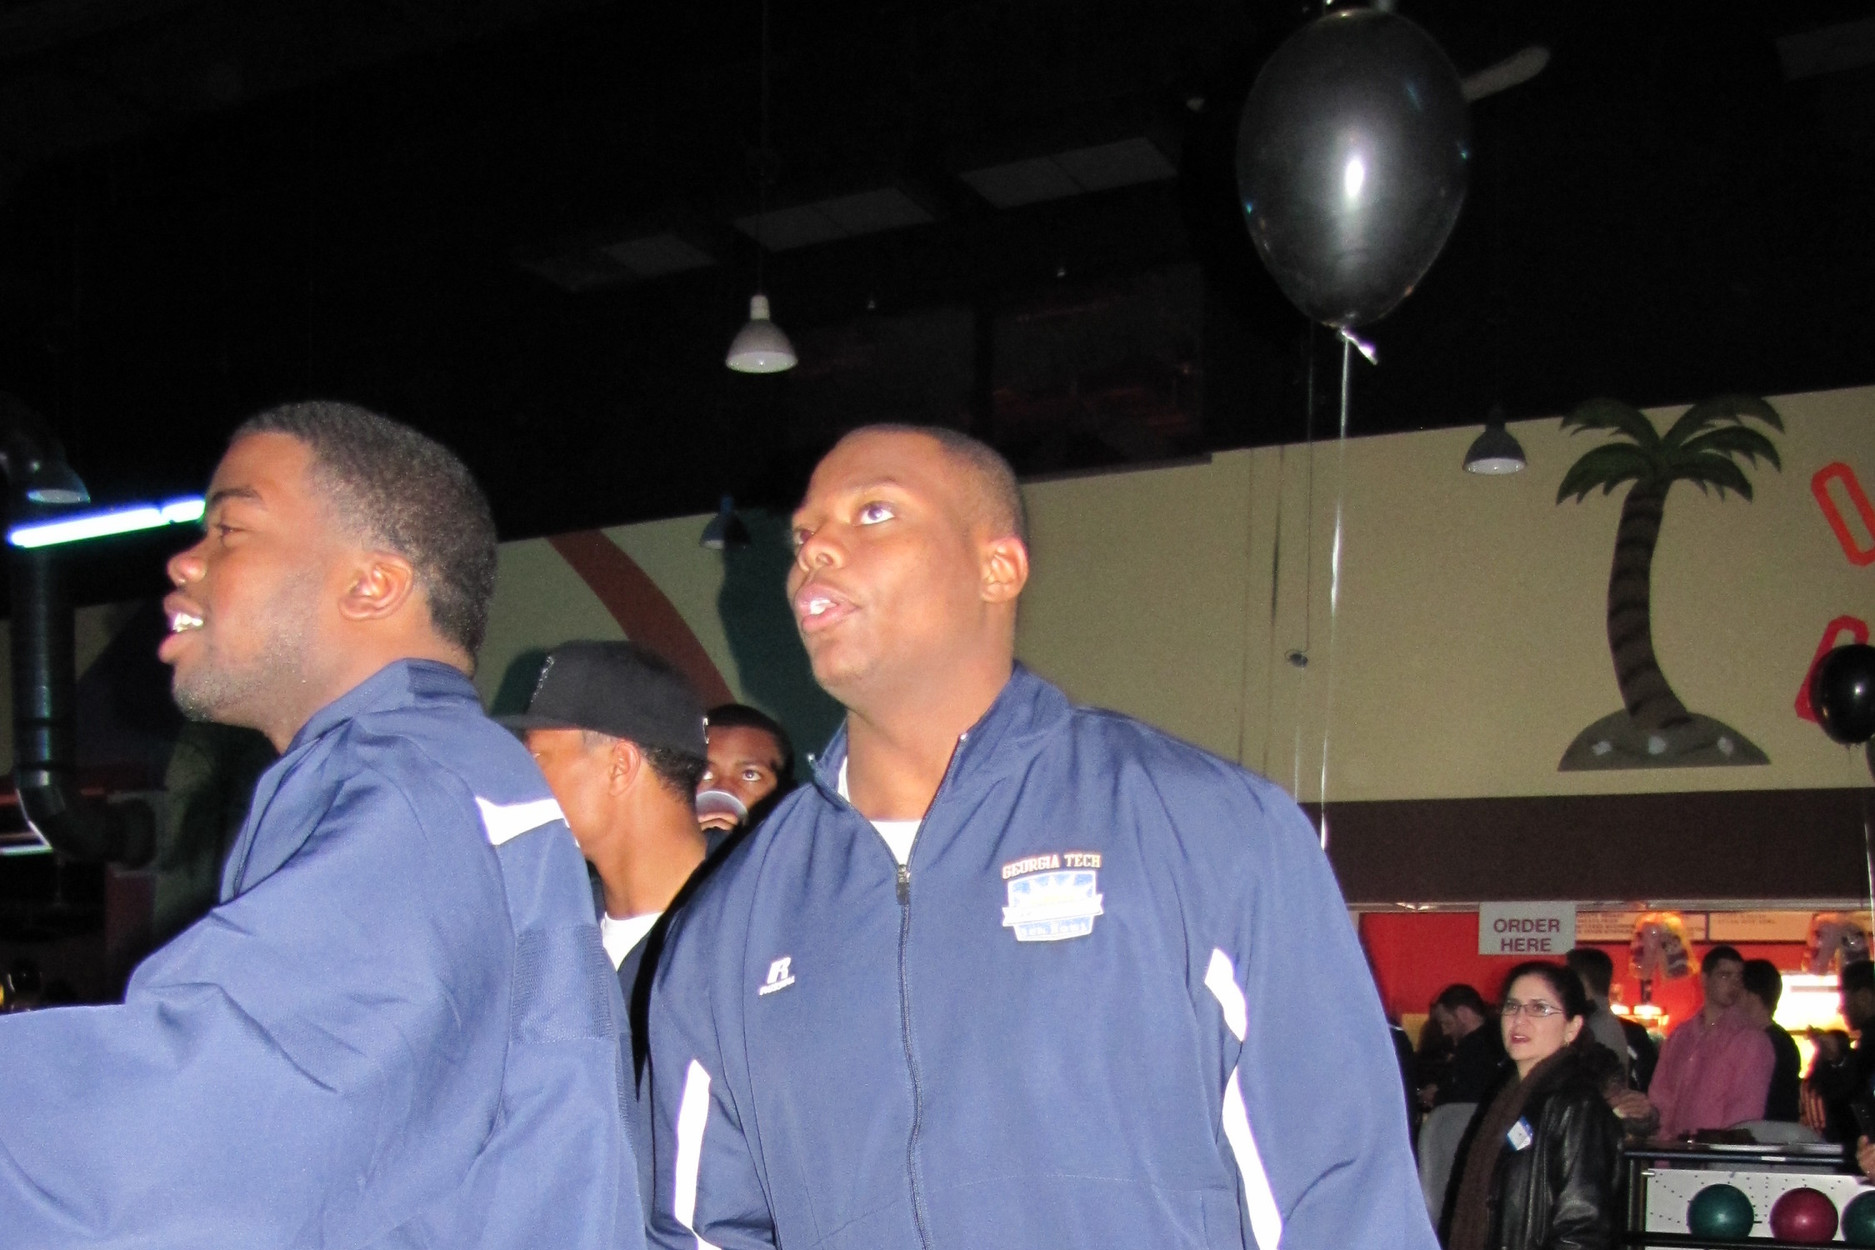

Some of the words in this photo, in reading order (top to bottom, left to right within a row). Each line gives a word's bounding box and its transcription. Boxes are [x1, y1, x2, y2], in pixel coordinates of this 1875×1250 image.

[1002, 854, 1060, 880] GEORGIA
[1063, 853, 1101, 868] TECH
[1493, 919, 1560, 933] ORDER
[1501, 938, 1551, 952] HERE
